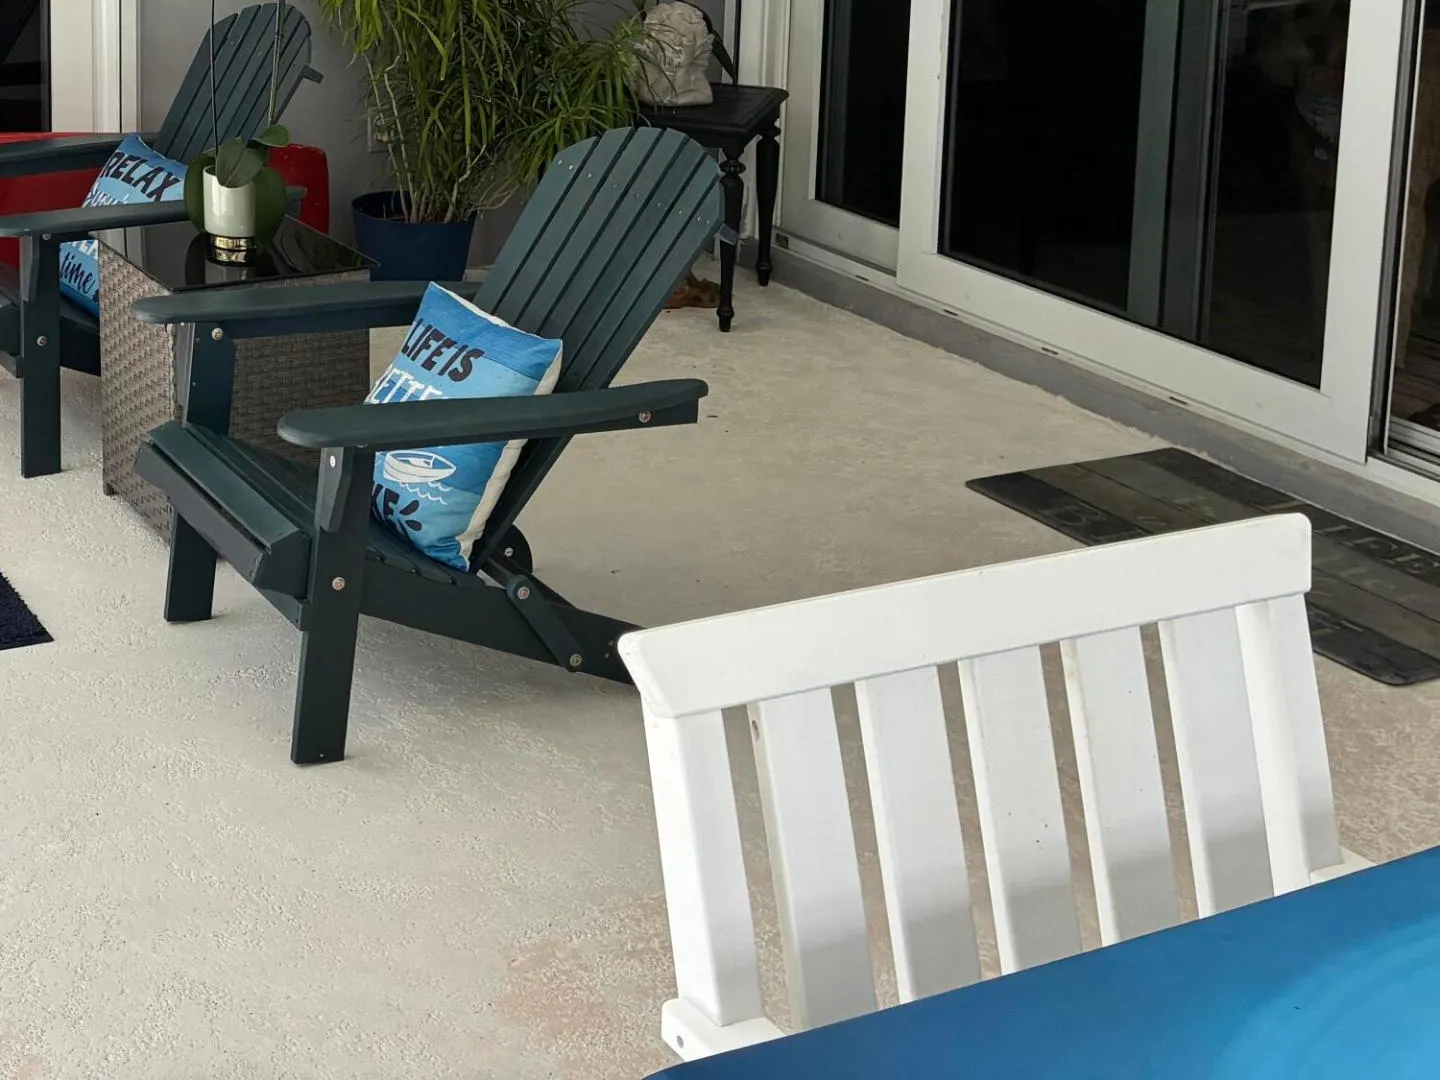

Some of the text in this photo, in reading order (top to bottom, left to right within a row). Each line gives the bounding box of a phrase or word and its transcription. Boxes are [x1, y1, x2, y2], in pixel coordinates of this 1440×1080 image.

[100, 151, 180, 201] RELAX
[60, 251, 97, 294] time
[401, 318, 485, 382] LIFE IS
